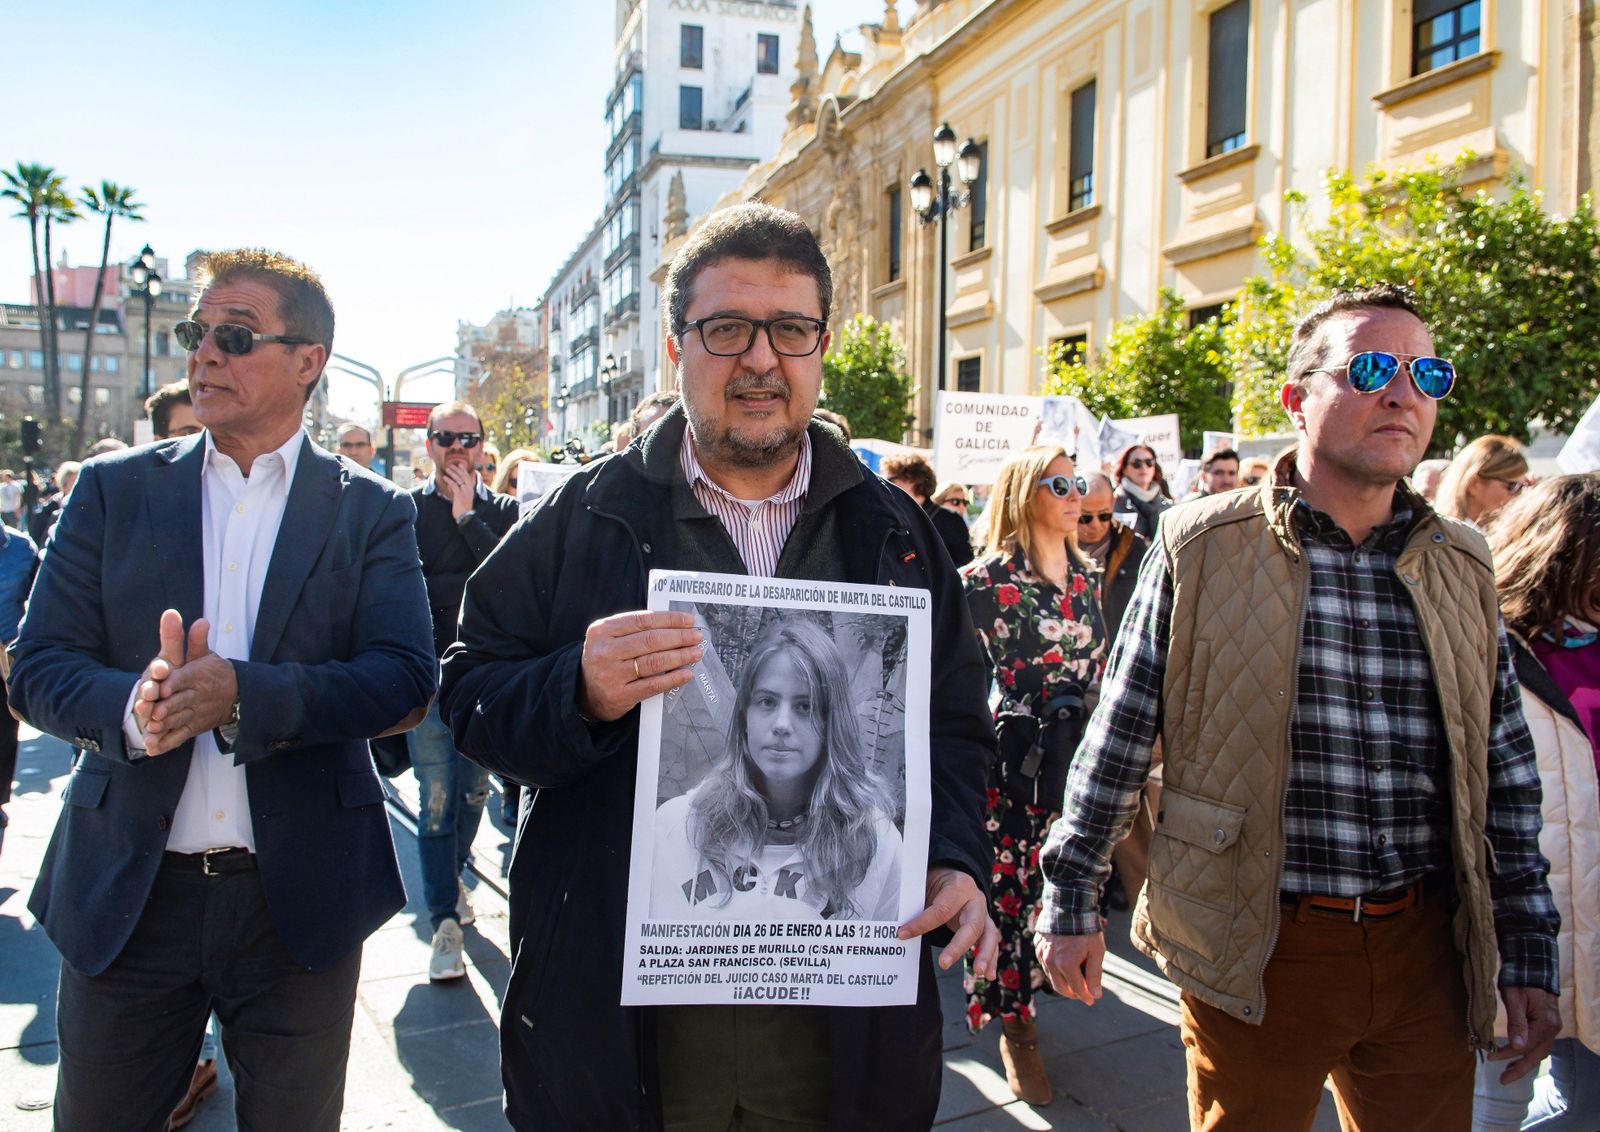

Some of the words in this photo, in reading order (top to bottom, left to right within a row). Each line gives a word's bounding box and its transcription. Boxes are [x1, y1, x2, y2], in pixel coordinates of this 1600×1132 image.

[945, 402, 1029, 417] COMUNIDAD
[975, 421, 992, 433] DE
[955, 437, 1010, 450] GALICIA
[669, 579, 733, 598] ANIVERSARIO
[734, 583, 747, 598] DE
[749, 584, 760, 599] LA
[763, 585, 826, 603] DESAPARICIÓN
[828, 590, 839, 604] DE
[841, 591, 869, 606] MARTA
[872, 593, 887, 607] DEL
[889, 594, 927, 610] CASTILLO
[641, 921, 731, 938] MANIFESTACIÓN
[733, 924, 752, 937] DIA
[754, 923, 767, 937] 26
[769, 924, 784, 937] DE
[786, 923, 822, 938] ENERO
[824, 924, 832, 937] A
[835, 925, 855, 938] LAS
[858, 925, 871, 939] 12
[639, 945, 682, 955] SALIDA:
[685, 945, 739, 955] JARDINES
[741, 944, 756, 954] DE
[758, 944, 805, 954] MURILLO
[808, 944, 843, 957] (C/SAN
[846, 945, 906, 957] FERNANDO)
[638, 958, 647, 968] A
[649, 958, 685, 968] PLAZA
[688, 958, 710, 968] SAN
[713, 957, 777, 967] FRANCISCO.
[779, 957, 831, 970] (SEVILLA)
[704, 973, 723, 984] DEL
[725, 973, 759, 984] JUICIO
[761, 973, 788, 984] CASO
[790, 973, 824, 984] MARTA
[826, 974, 845, 985] DEL
